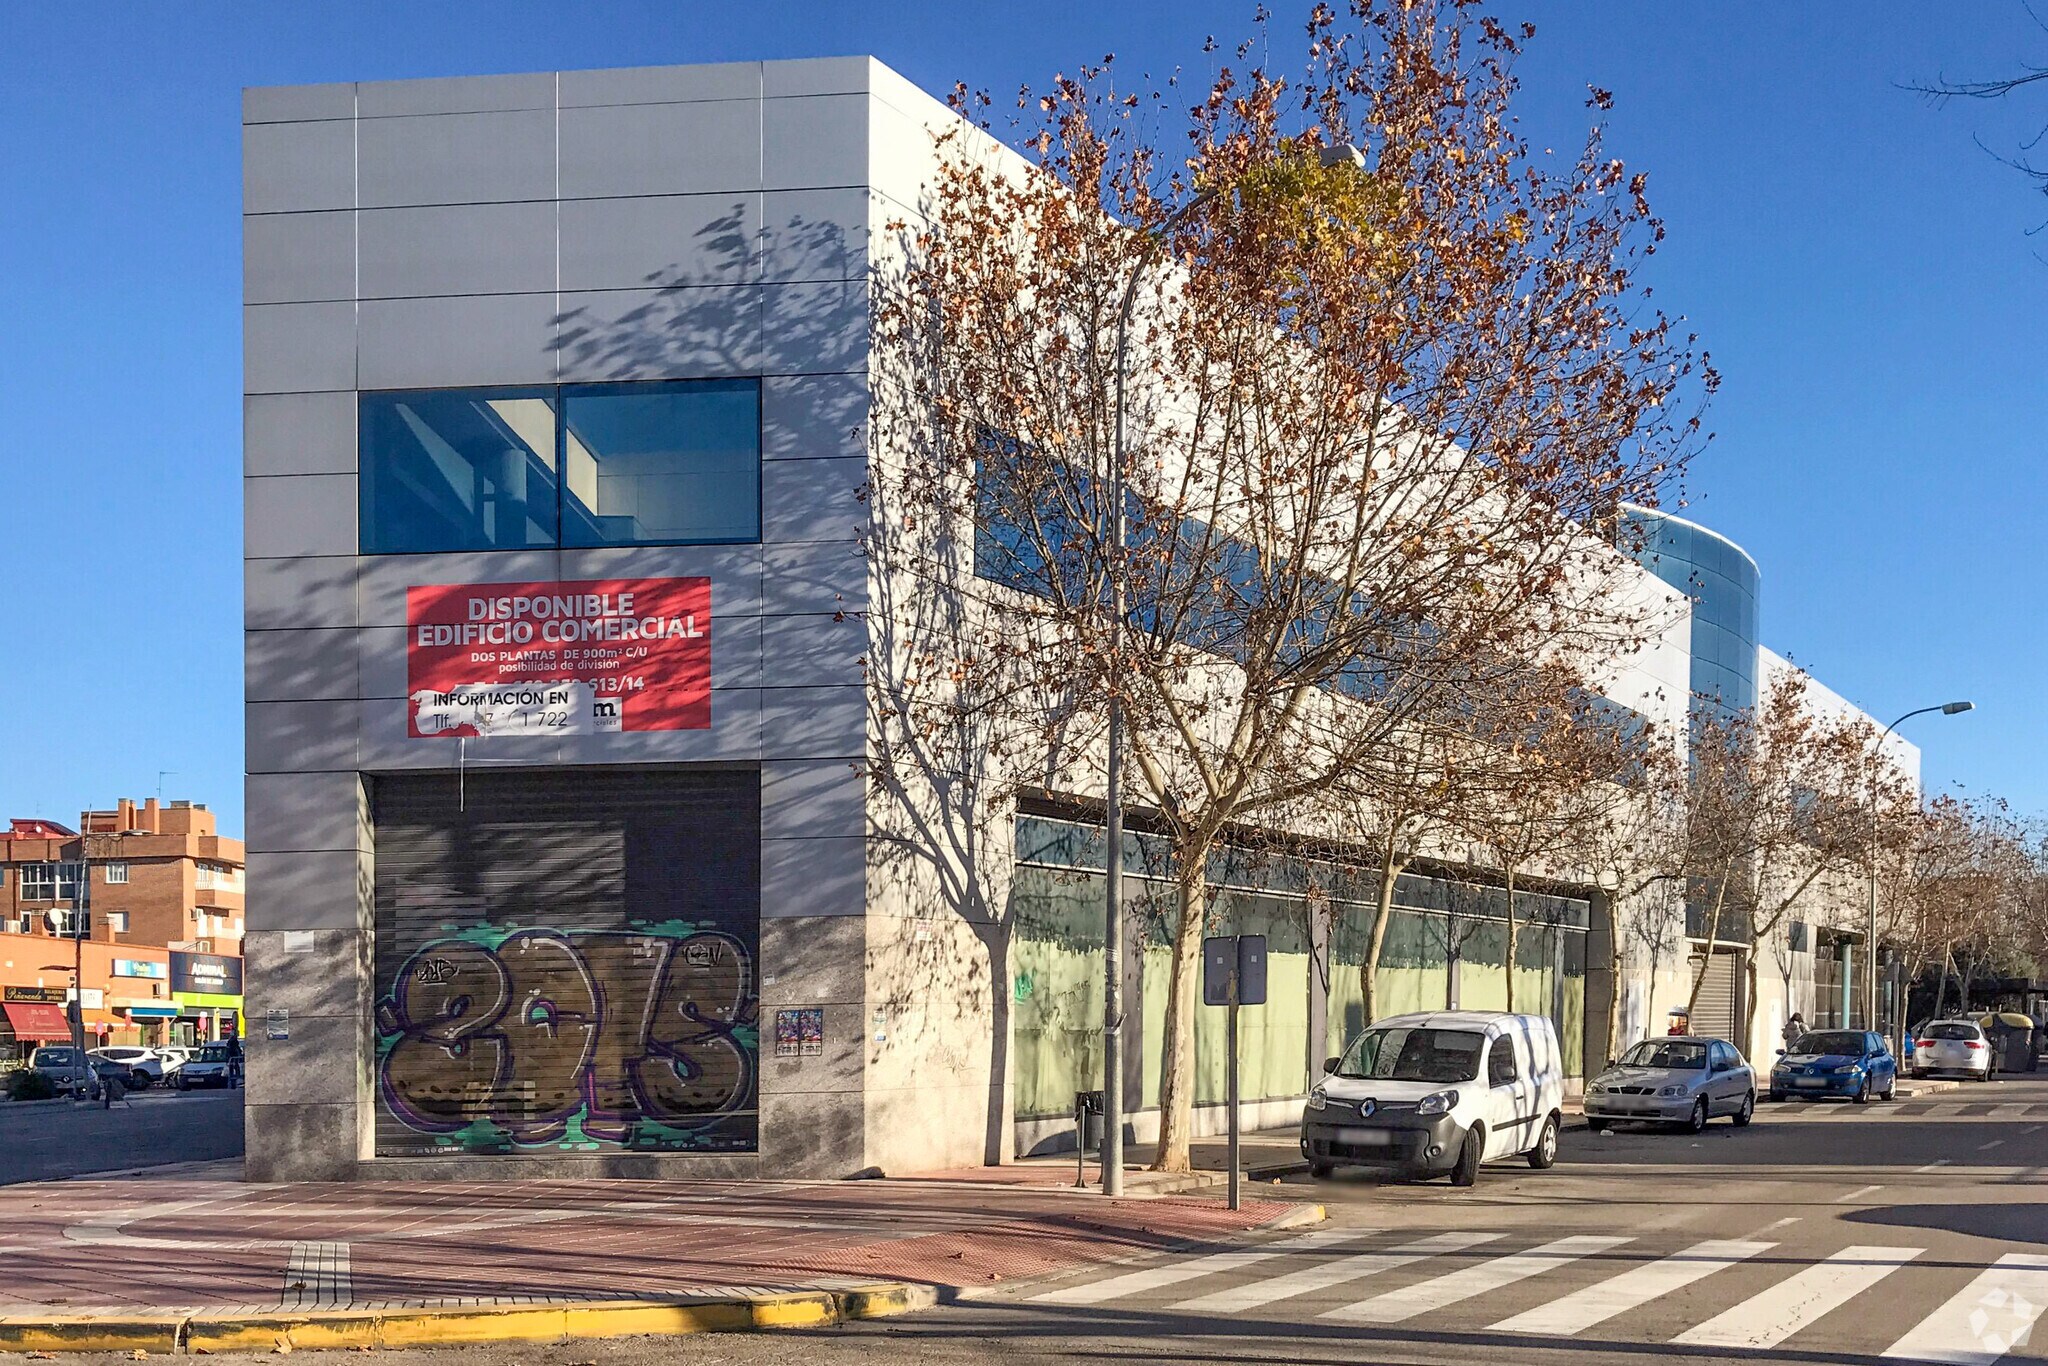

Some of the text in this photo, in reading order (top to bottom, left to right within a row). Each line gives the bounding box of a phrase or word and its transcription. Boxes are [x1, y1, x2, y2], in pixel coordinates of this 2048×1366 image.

[468, 593, 634, 620] DISPONIBLE
[418, 615, 703, 647] EDIFICIO COMERCIAL
[471, 652, 496, 662] DOS
[500, 650, 556, 661] PLANTAS
[564, 649, 579, 659] DE
[625, 646, 648, 658] C/U
[499, 658, 620, 674] posibilidad de división
[433, 688, 569, 706] INFORMACIÓN EN
[537, 712, 568, 727] 722
[191, 962, 227, 978] ADMIRAL
